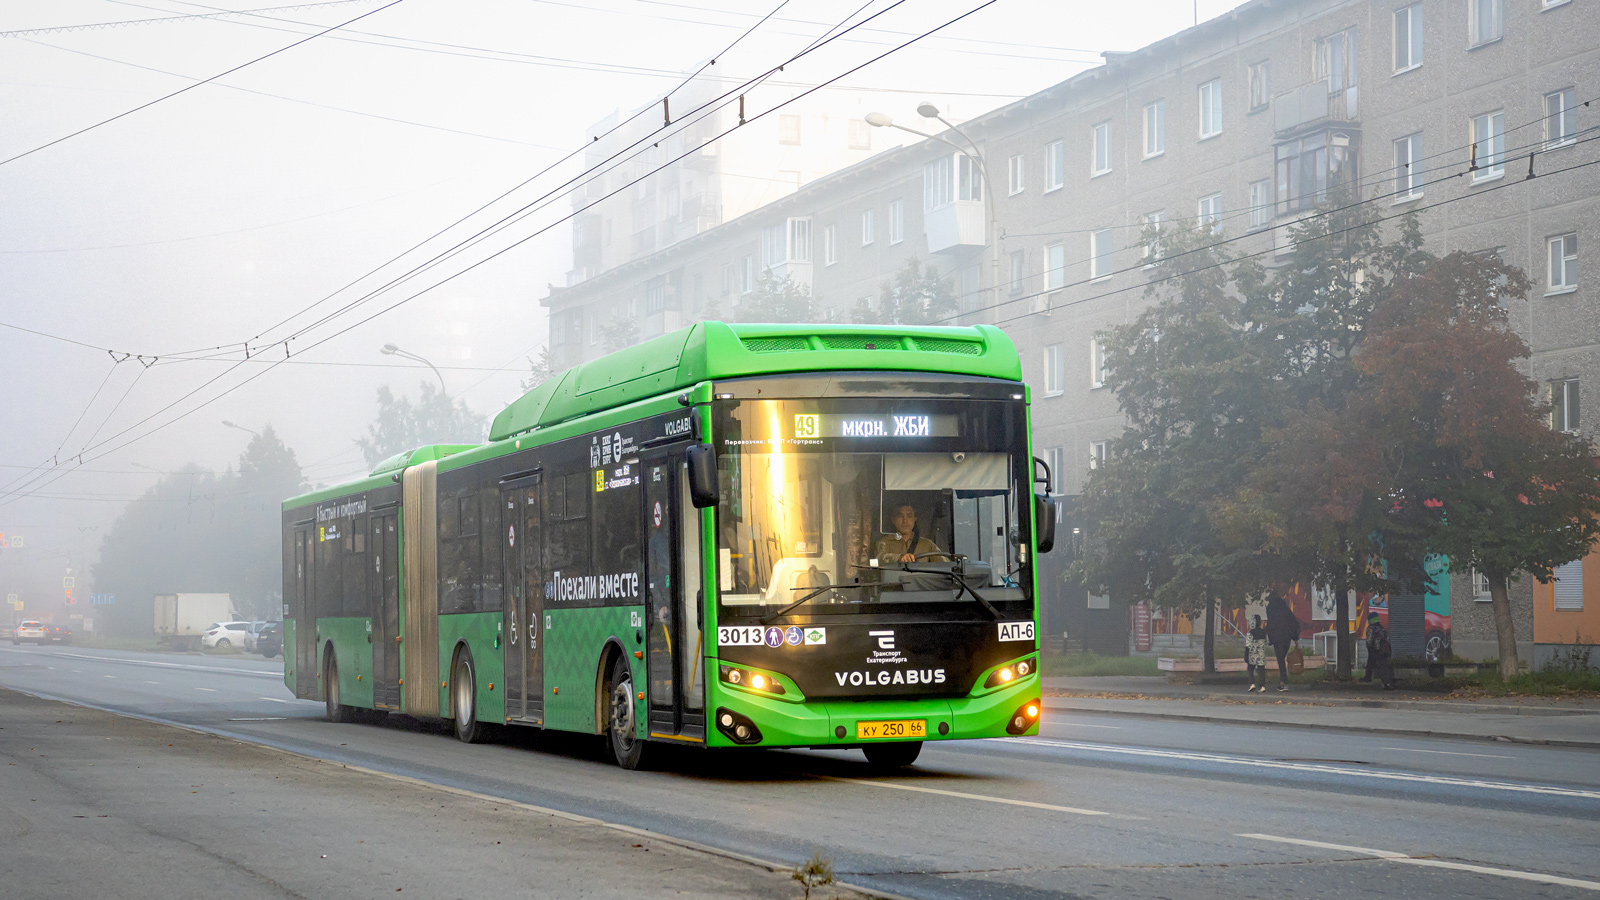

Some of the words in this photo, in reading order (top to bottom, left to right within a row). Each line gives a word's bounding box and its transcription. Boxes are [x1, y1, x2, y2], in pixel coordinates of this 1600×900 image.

[665, 417, 692, 435] VOLGABU
[795, 416, 815, 436] 49
[842, 421, 888, 437] мкрн.
[893, 416, 929, 436] ЖБИ
[786, 438, 824, 446] «Гортранс»
[554, 571, 597, 601] Поехали
[599, 572, 639, 599] вместе
[720, 628, 762, 644] 3013
[1000, 624, 1033, 640] АП-6
[872, 650, 901, 658] Транспорт
[835, 668, 946, 687] VOLGABUS
[863, 726, 878, 737] КУ
[882, 723, 904, 736] 250
[910, 722, 922, 731] 66
